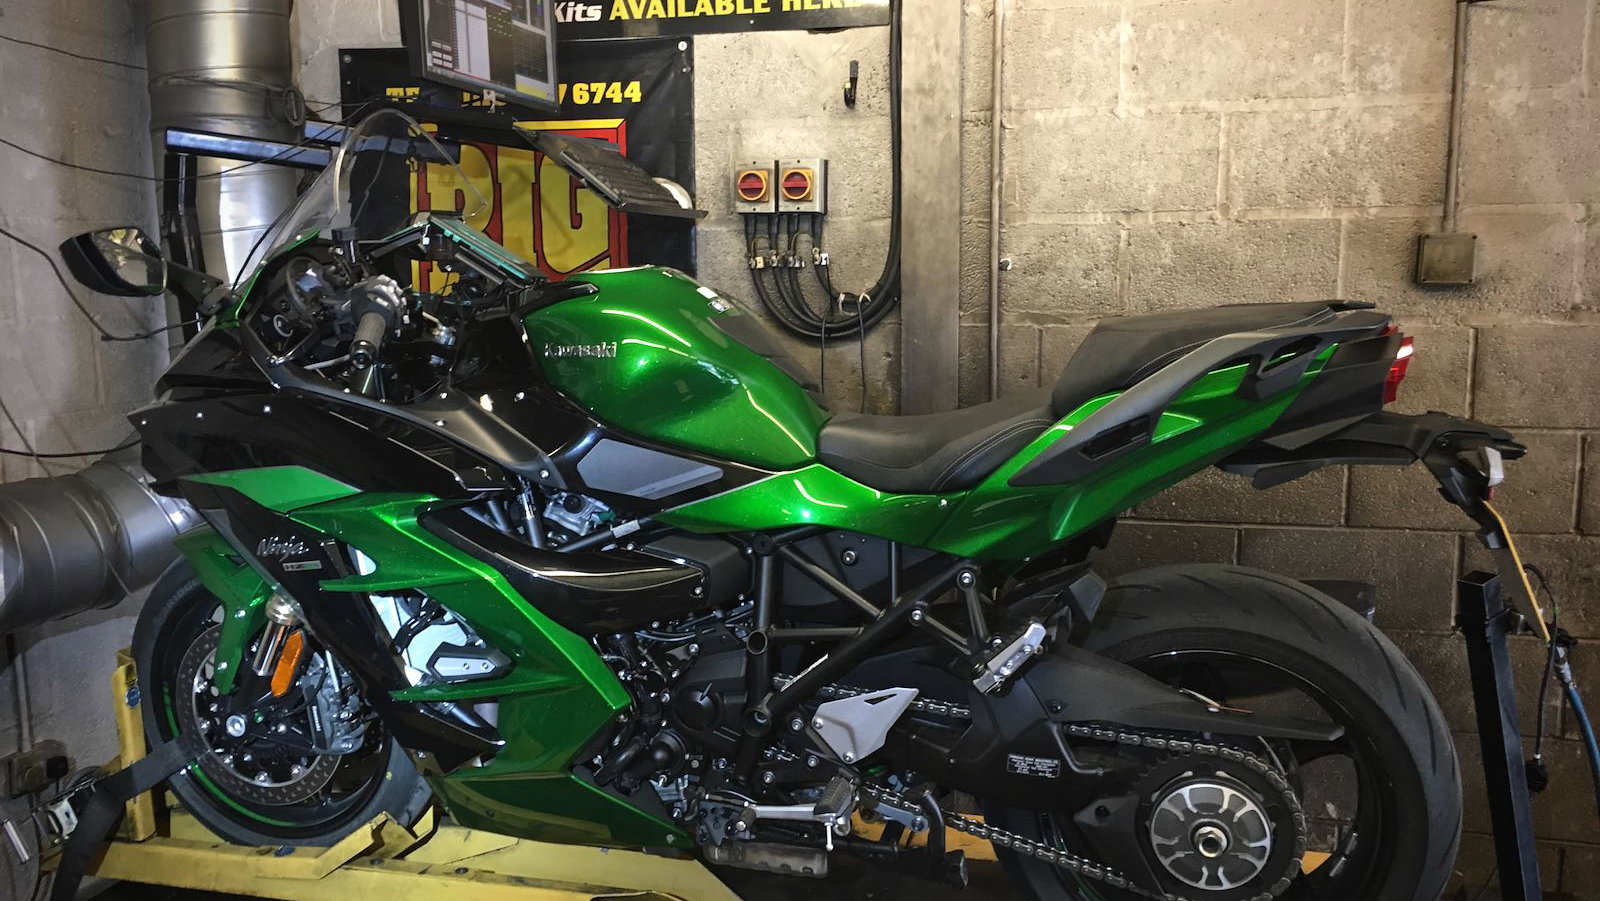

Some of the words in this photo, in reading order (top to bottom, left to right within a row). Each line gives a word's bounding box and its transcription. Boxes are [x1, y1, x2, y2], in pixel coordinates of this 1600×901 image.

[554, 1, 603, 23] Kits
[608, 0, 771, 21] AVAILABLE
[572, 81, 642, 104] 6744
[544, 341, 618, 358] Kawasaki
[256, 535, 310, 562] Ninja
